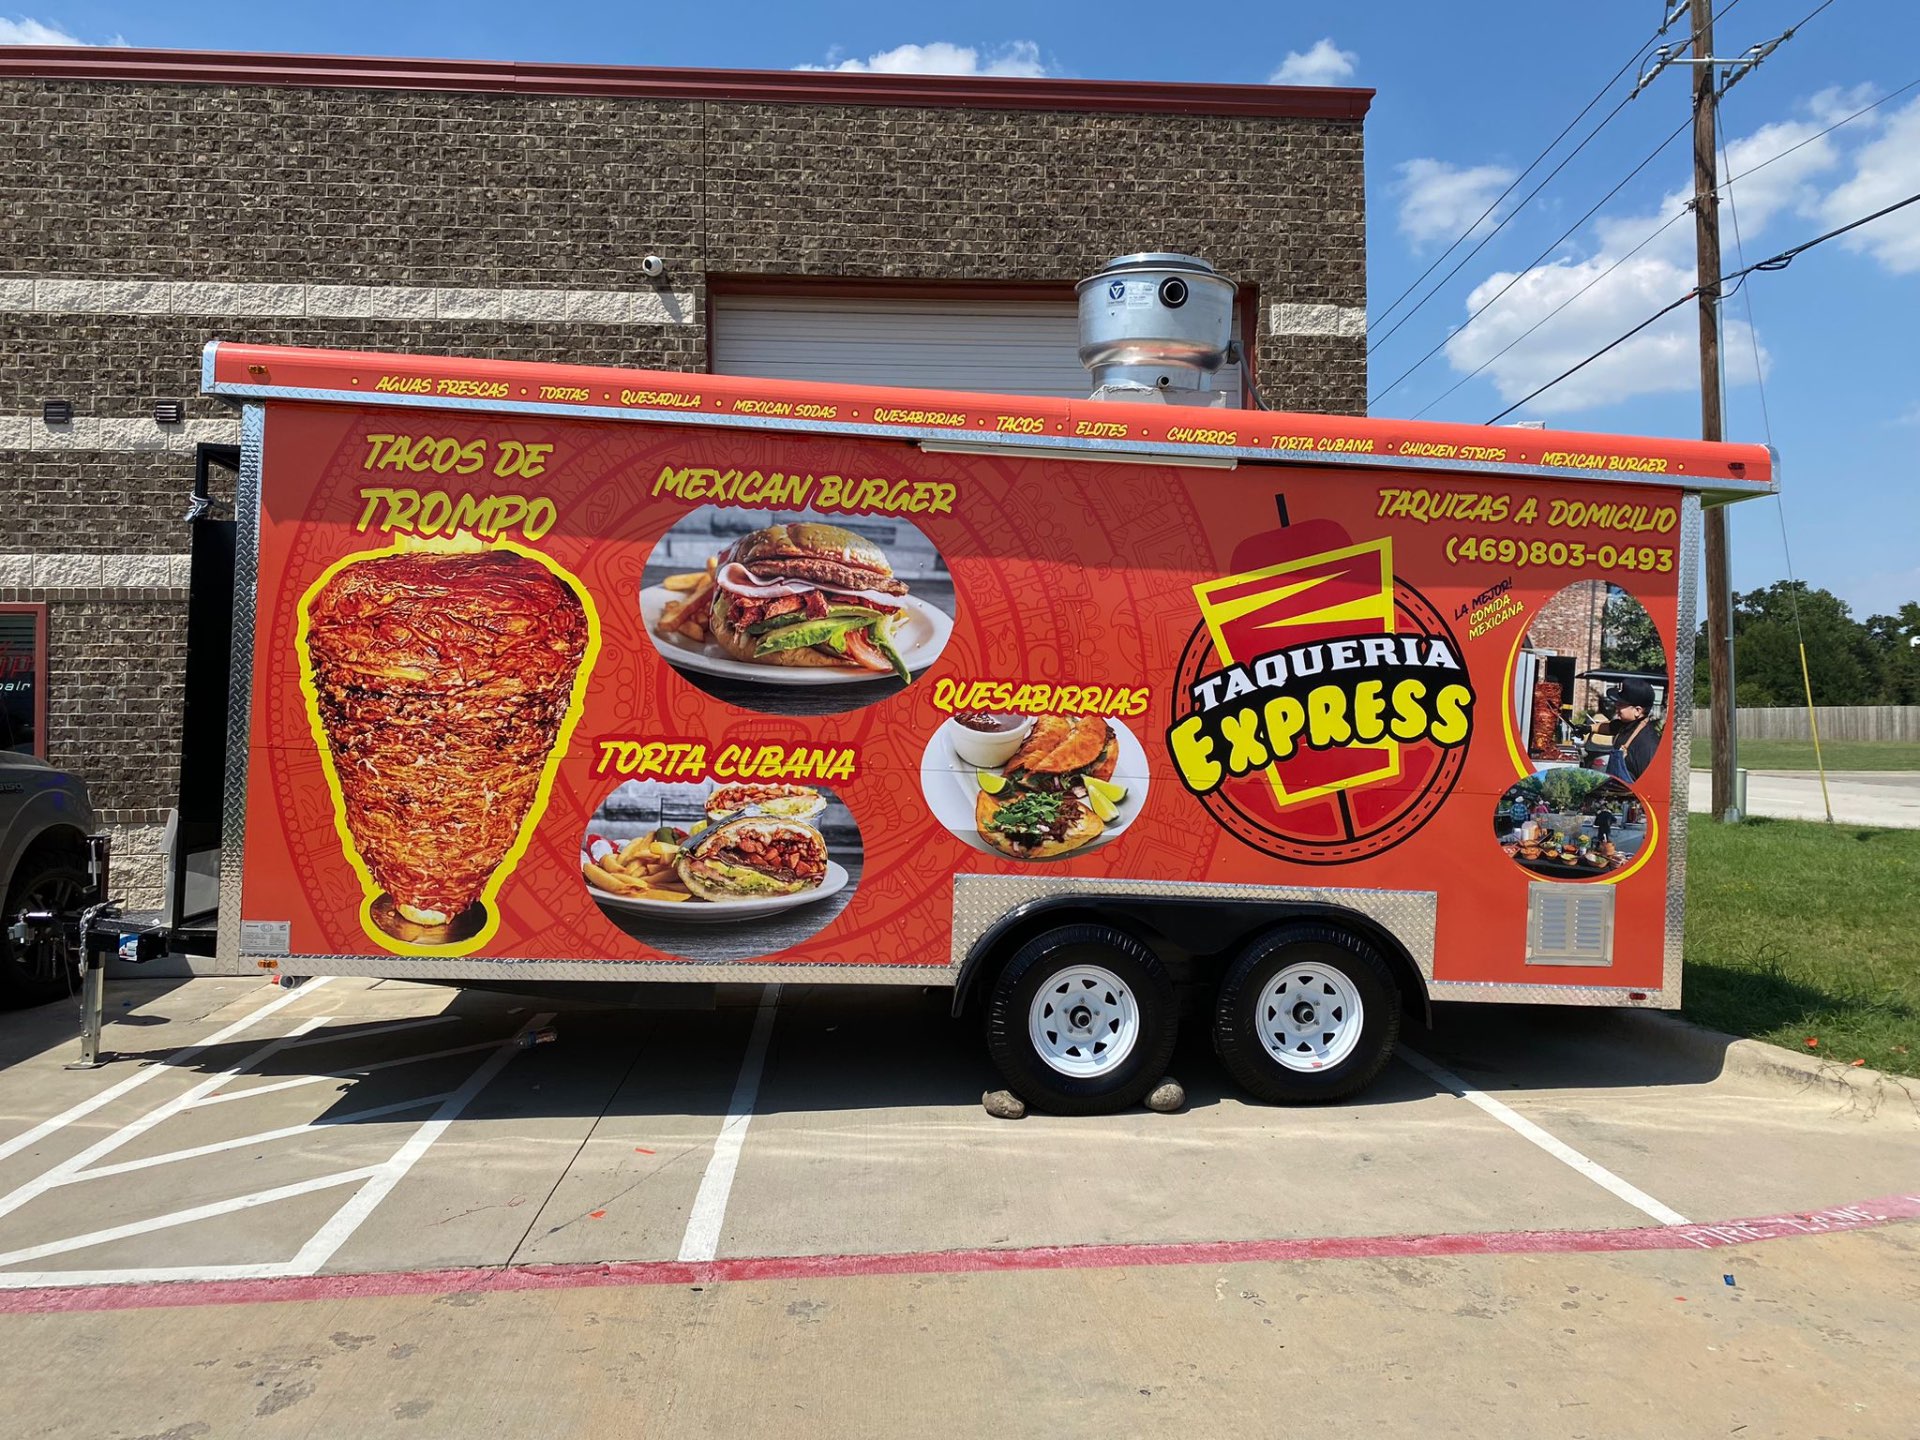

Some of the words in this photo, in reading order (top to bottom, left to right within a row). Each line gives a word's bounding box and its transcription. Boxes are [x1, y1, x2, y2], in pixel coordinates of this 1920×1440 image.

[374, 376, 432, 394] AGUAS
[436, 379, 509, 398] FRESCAS
[539, 386, 590, 402] TORTAS
[620, 389, 701, 407] QUESADILLA
[732, 399, 793, 416] MEXICAN
[794, 404, 838, 419] SODAS
[873, 408, 966, 427] QUESABIRRIAS
[995, 416, 1044, 434] TACOS
[1075, 422, 1129, 437] ELOTES
[1167, 427, 1237, 445] CHURROS
[1271, 435, 1314, 451] TORTA
[1316, 437, 1374, 453] CUBANA
[363, 433, 487, 477] TACOS
[493, 441, 554, 479] DE
[1399, 441, 1458, 458] CHICKEN
[1458, 445, 1507, 462] STRIPS
[1540, 451, 1607, 470] MEXICAN
[1608, 456, 1668, 473] BURGER
[651, 466, 814, 505] MEXICAN
[815, 471, 957, 514] BURGER
[356, 488, 557, 541] TROMPO
[1377, 489, 1510, 523] TAQUIZAS
[1513, 495, 1538, 524] A
[1547, 499, 1678, 534] DOMICILIO
[1445, 536, 1674, 573] (469)803-0493
[1454, 603, 1469, 622] LA
[1471, 576, 1513, 610] MEJOR!
[1469, 593, 1511, 625] COMIDA
[1468, 601, 1524, 641] MEXICANA
[1193, 637, 1461, 712] TAQUERIA
[932, 677, 1150, 717] QUESABIRRIAS
[1171, 679, 1472, 791] EXPRESS
[595, 740, 707, 779] TORTA
[713, 743, 856, 781] CUBANA
[1679, 1221, 1776, 1249] FIRE
[1777, 1206, 1887, 1232] LANE
